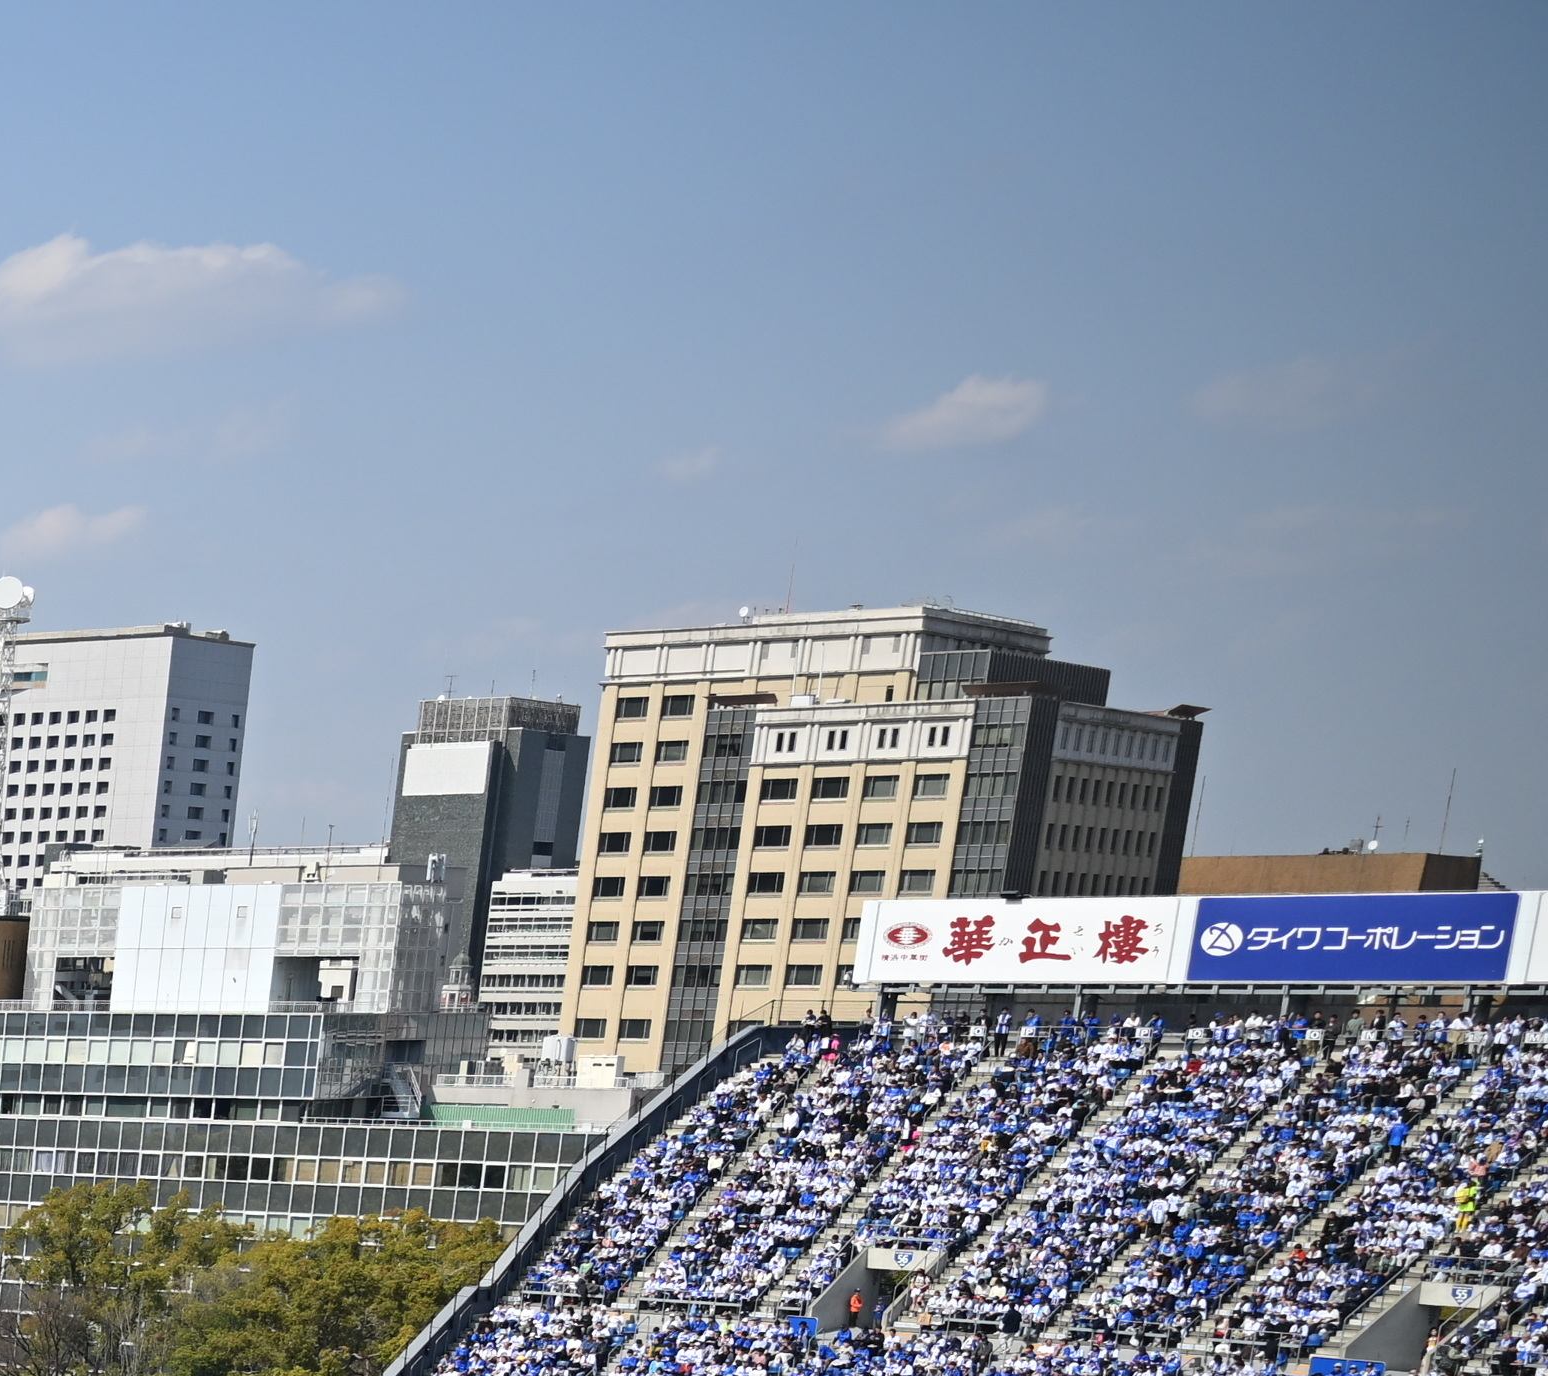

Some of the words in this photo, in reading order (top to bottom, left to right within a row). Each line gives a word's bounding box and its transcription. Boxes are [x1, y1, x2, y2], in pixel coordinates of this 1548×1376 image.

[1247, 925, 1505, 952] タイワコーポレーション
